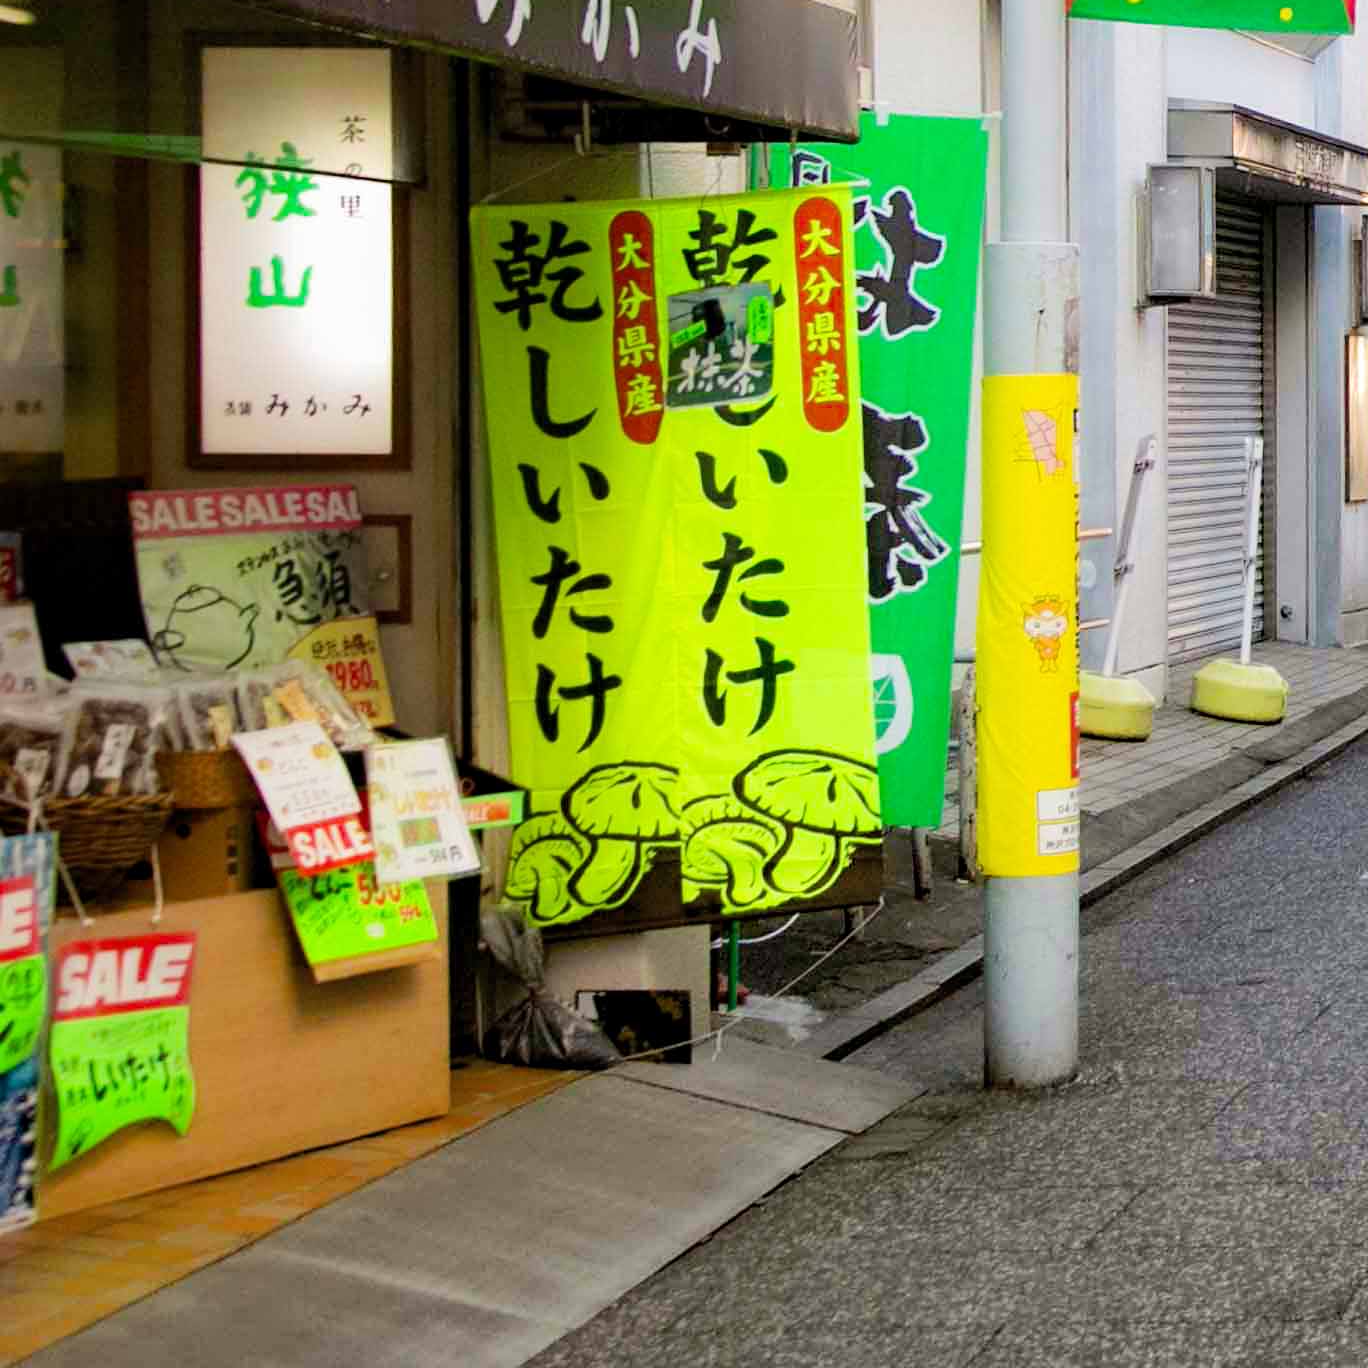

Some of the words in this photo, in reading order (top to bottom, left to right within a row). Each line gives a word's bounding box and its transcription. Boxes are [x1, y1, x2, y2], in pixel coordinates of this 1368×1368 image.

[340, 114, 367, 218] 茶の里
[235, 140, 322, 310] 狭山
[614, 233, 662, 417] 大分県産
[800, 219, 846, 404] 大分県産
[265, 393, 372, 419] みかみ
[677, 337, 764, 396] 抹茶
[491, 219, 622, 754] 乾しいたけ
[272, 550, 361, 625] 急須
[292, 818, 375, 870] SALE
[58, 942, 194, 1012] SALE
